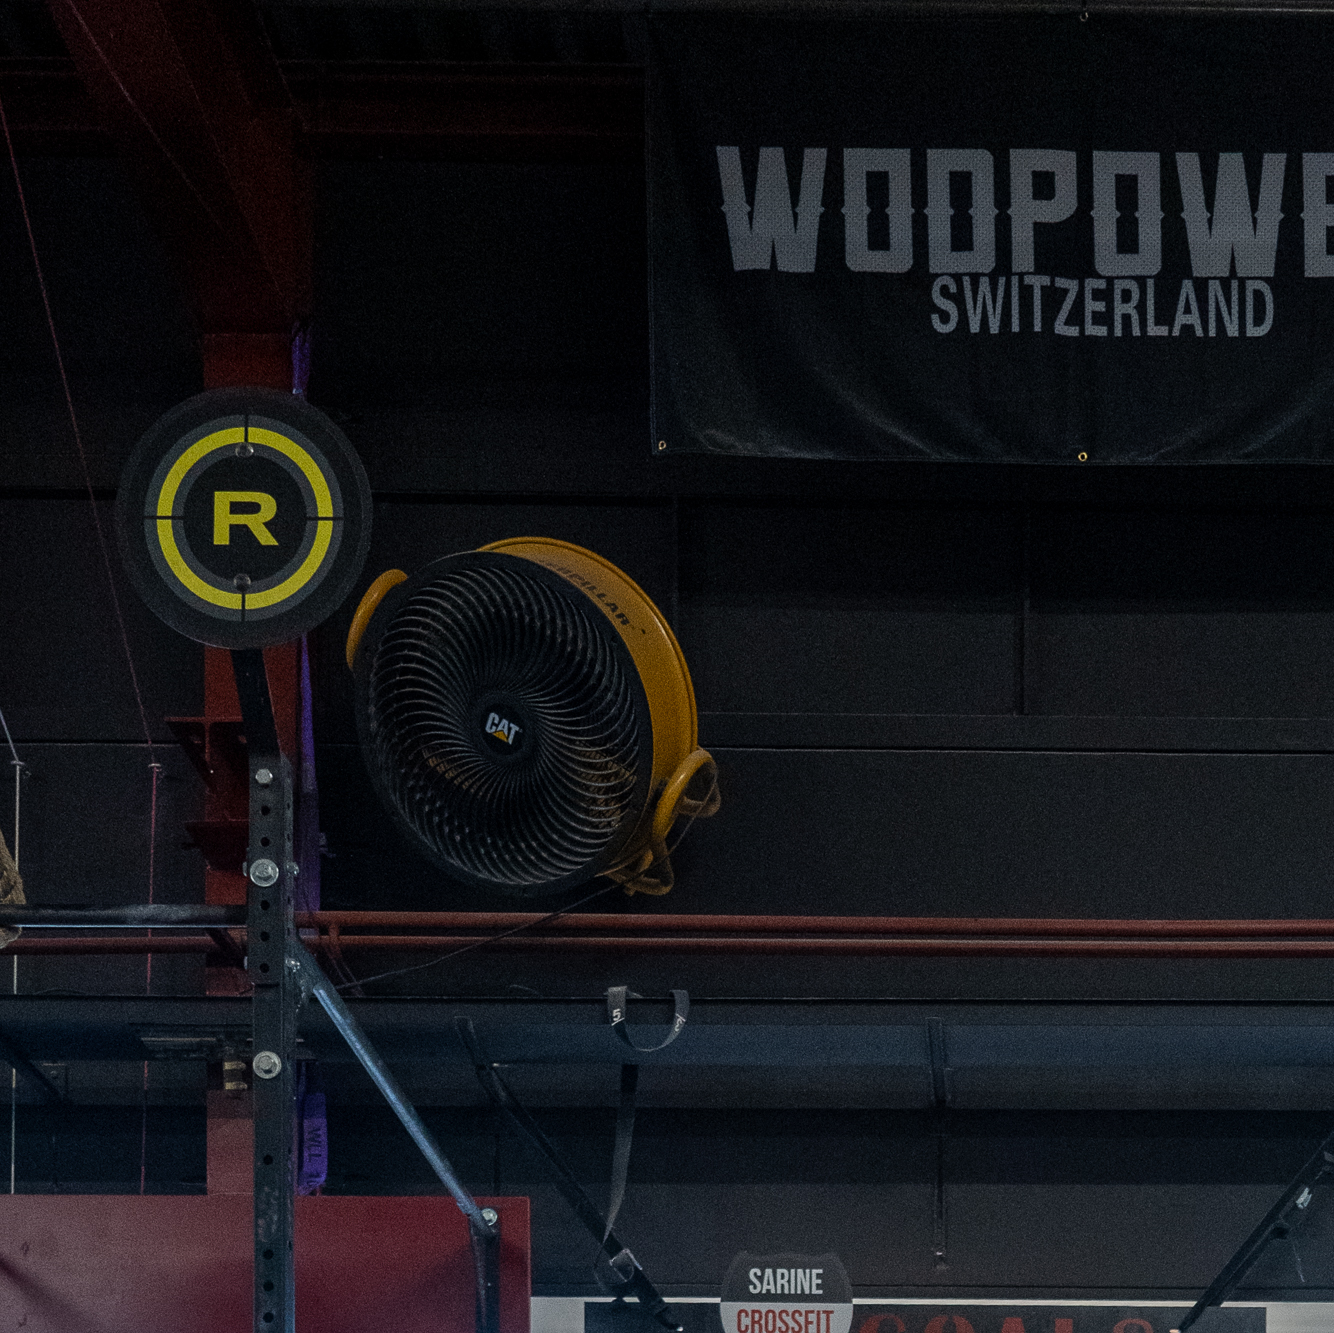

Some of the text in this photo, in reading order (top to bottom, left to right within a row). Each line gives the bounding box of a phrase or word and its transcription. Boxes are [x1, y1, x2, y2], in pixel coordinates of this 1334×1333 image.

[930, 275, 1275, 338] SWITZERLAND
[212, 491, 279, 546] R
[485, 712, 520, 745] CAT
[748, 1267, 824, 1295] SARINE
